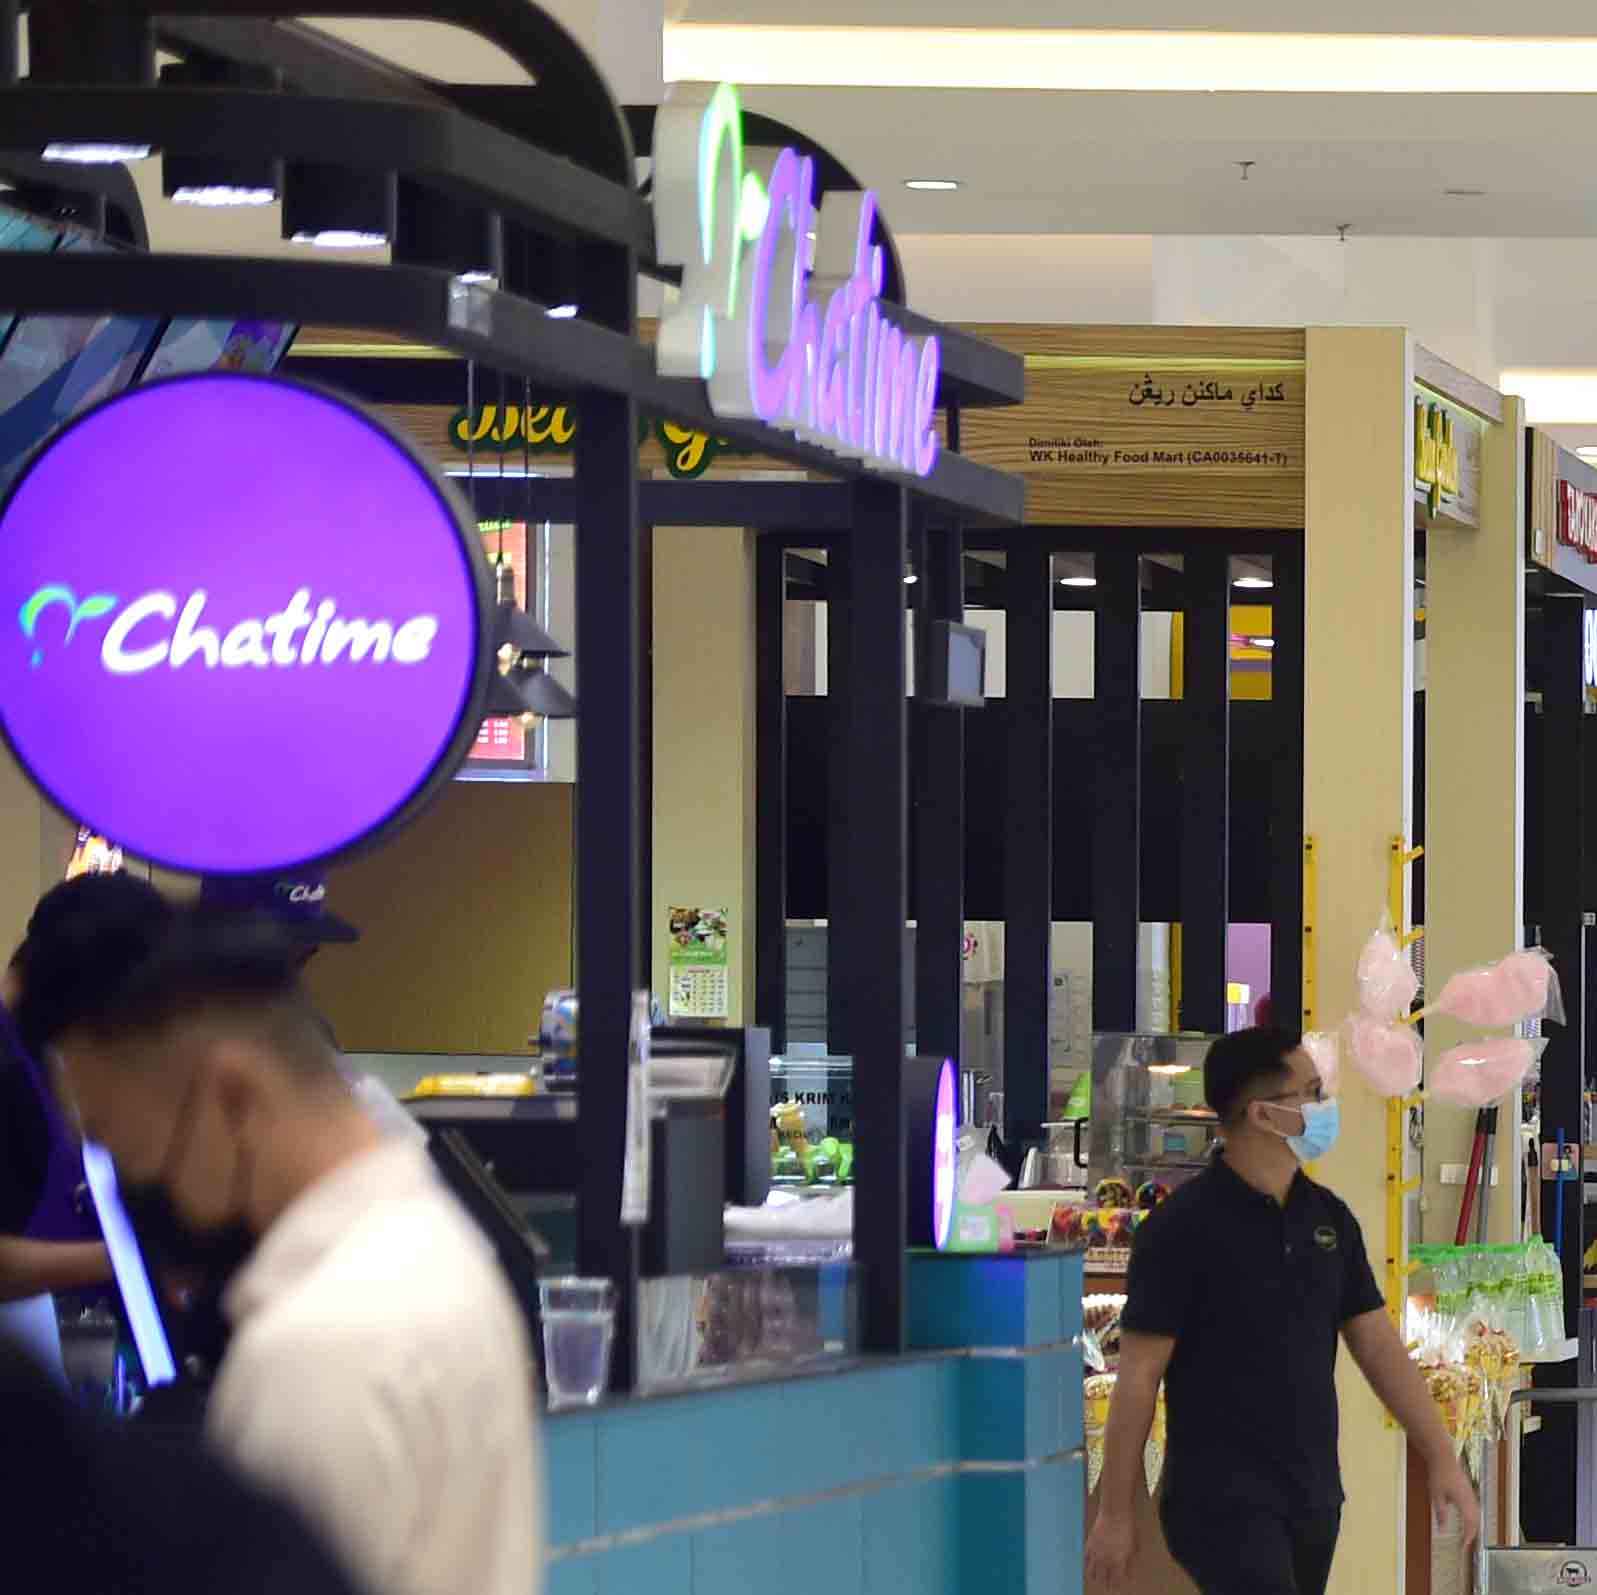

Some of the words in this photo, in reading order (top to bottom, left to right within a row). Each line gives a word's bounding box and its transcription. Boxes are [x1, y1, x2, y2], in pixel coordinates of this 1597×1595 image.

[1029, 451, 1054, 463] WK
[1057, 450, 1109, 465] Healthy
[1113, 451, 1148, 464] Food
[1152, 451, 1184, 464] Mart
[101, 588, 438, 673] Chatime
